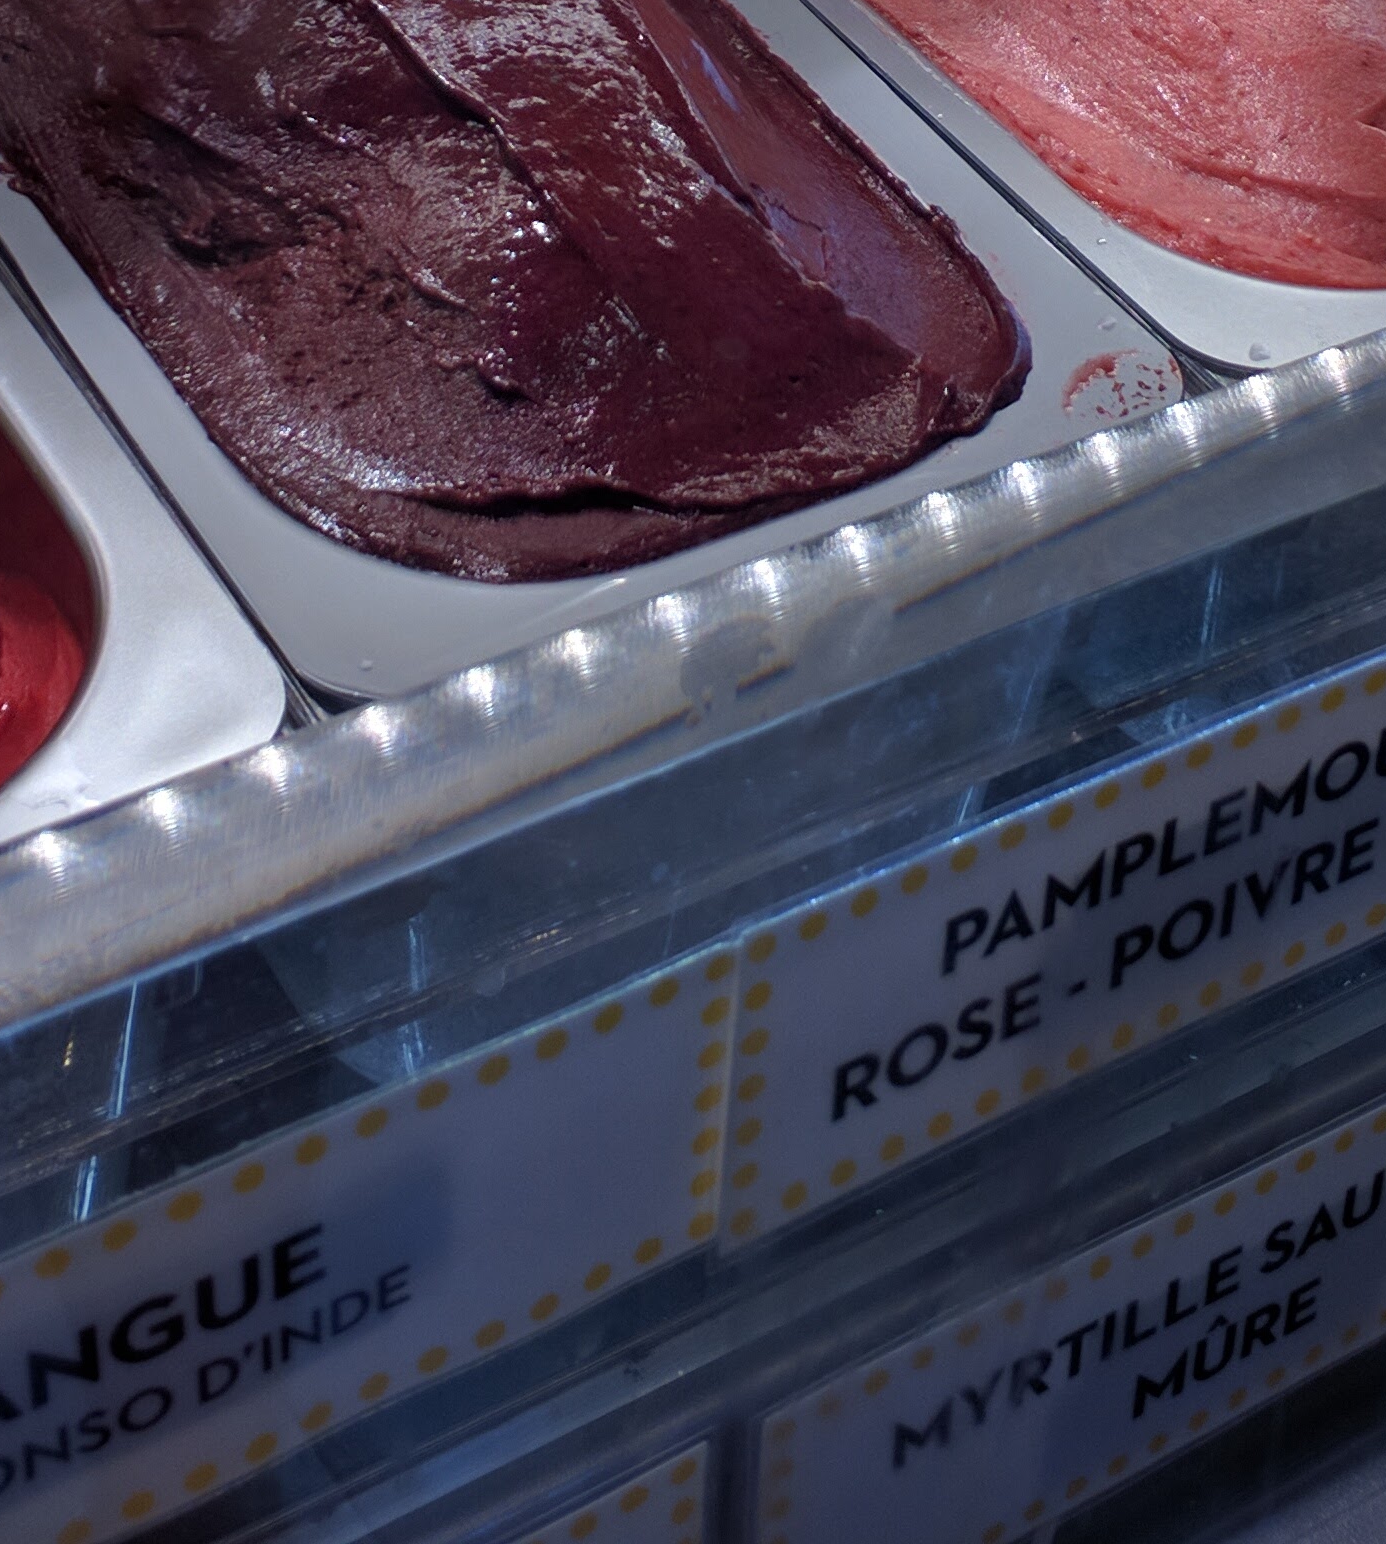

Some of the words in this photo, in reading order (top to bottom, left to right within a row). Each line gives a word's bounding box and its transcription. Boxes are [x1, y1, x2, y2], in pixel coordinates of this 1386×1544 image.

[830, 972, 1043, 1123] ROSE
[1067, 979, 1088, 997] -
[1109, 823, 1377, 986] POIVRE
[891, 1245, 1241, 1470] MYRTILLE
[1131, 1279, 1321, 1418] MÛRE
